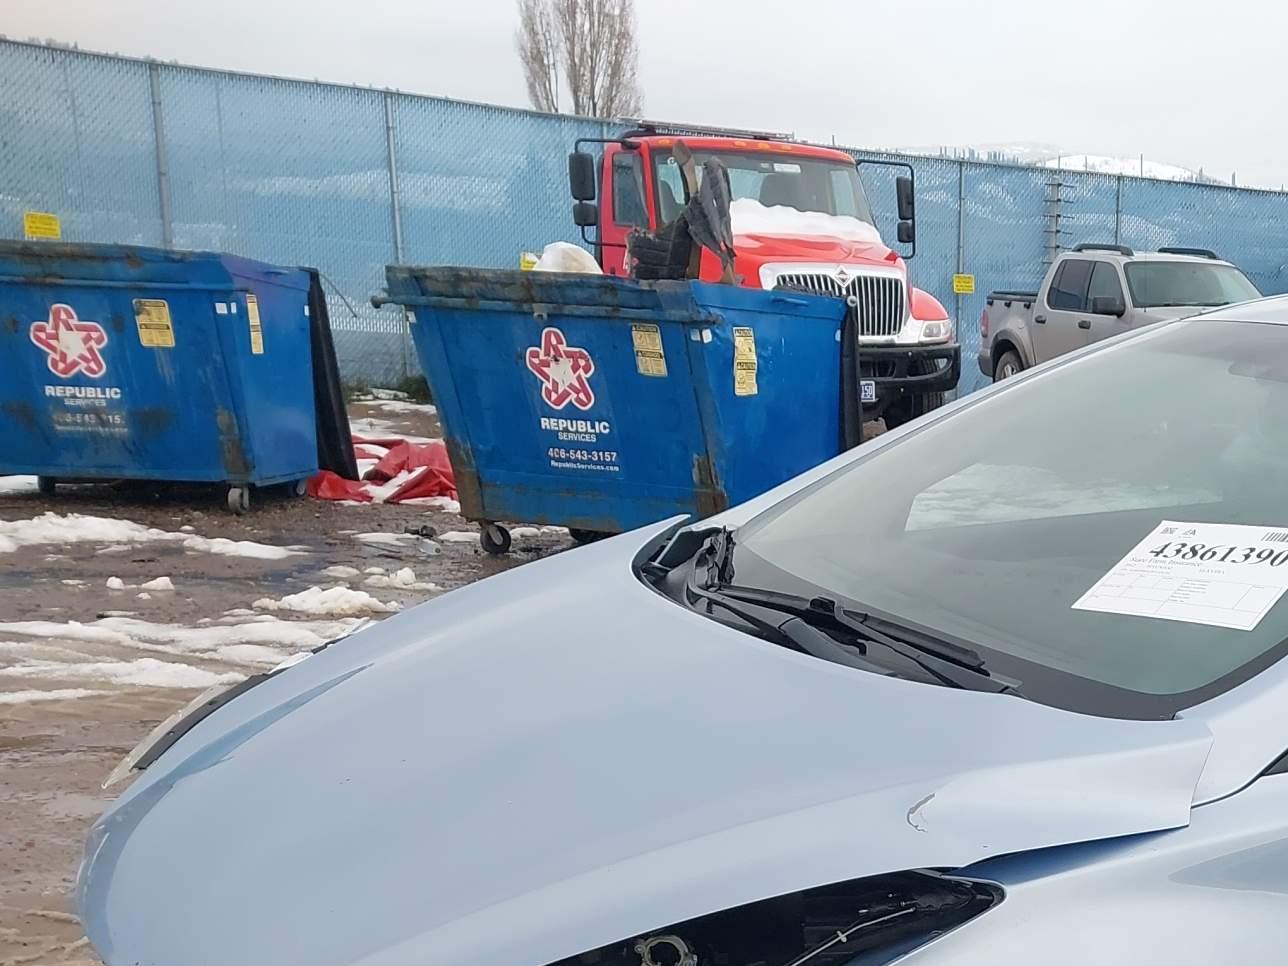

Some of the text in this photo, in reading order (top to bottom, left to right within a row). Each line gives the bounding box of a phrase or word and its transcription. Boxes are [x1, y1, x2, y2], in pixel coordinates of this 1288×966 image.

[45, 385, 121, 398] REPUBLIC
[540, 418, 610, 433] REPUBLIC
[558, 432, 597, 442] SERVICES
[548, 448, 617, 461] 406-543-3157
